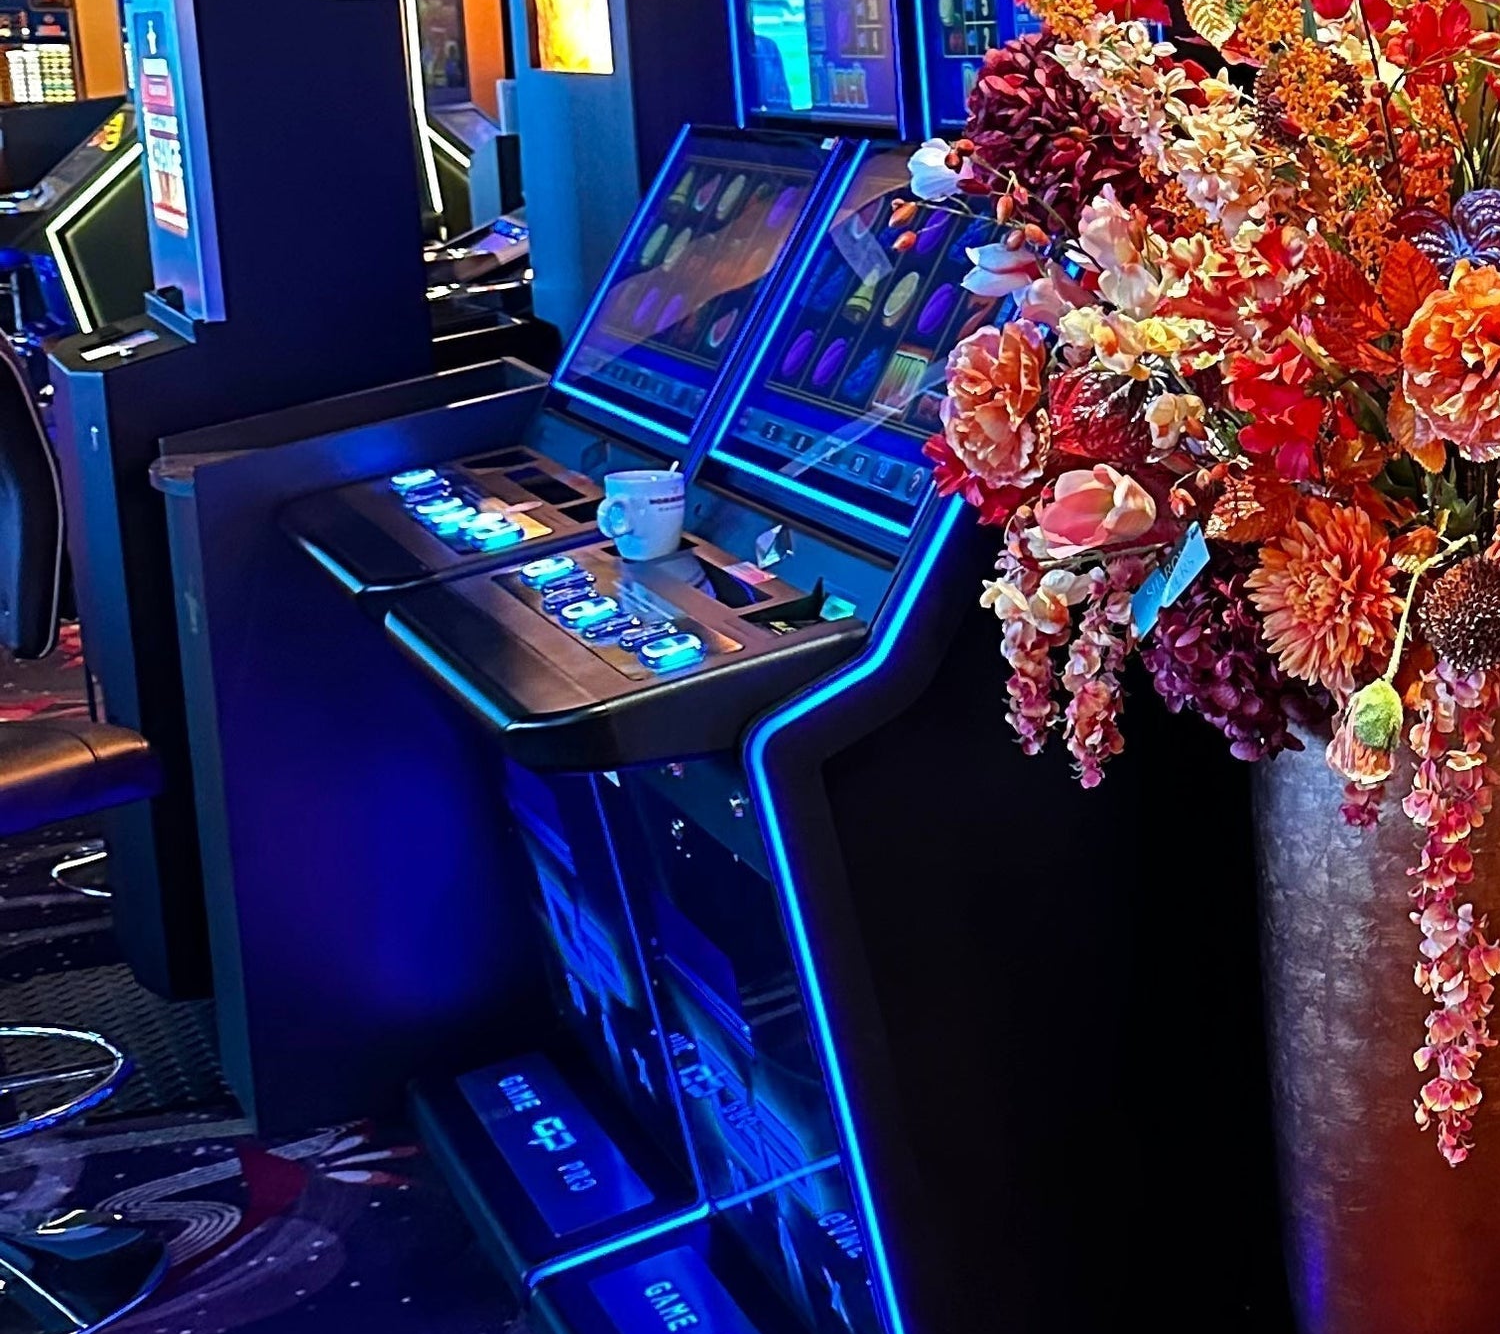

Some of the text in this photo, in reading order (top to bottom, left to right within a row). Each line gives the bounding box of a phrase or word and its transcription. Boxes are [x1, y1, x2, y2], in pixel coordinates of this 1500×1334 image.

[498, 1074, 542, 1113] GAME
[557, 1159, 597, 1192] PRO
[644, 1280, 698, 1333] GAME
